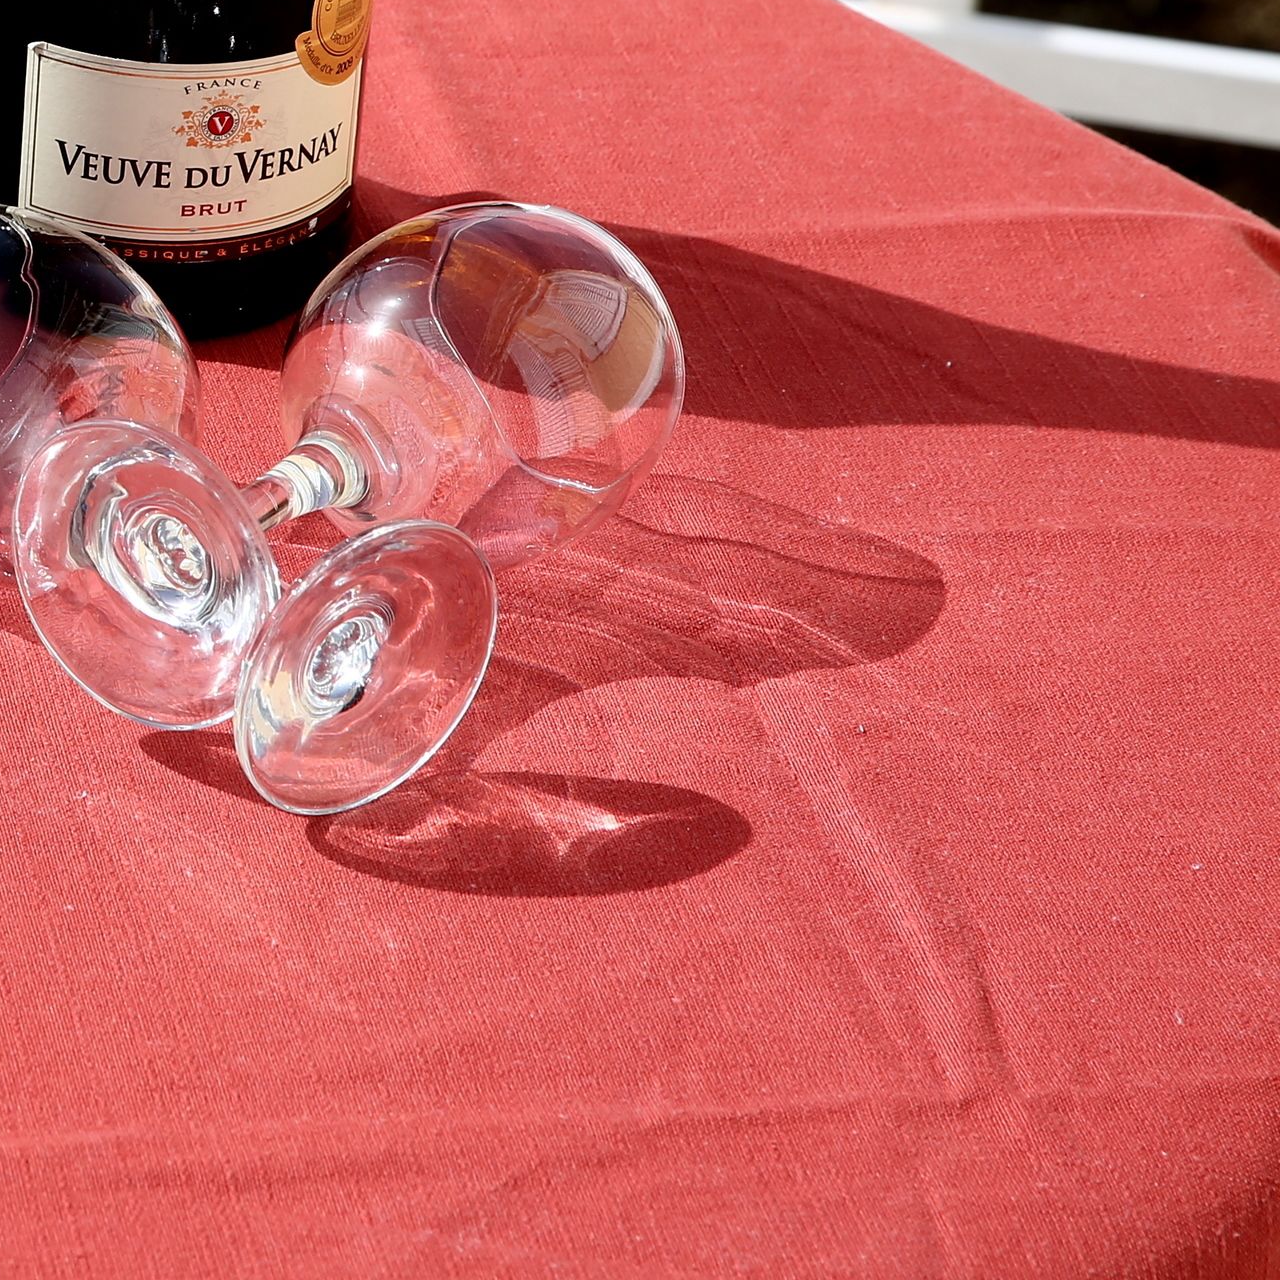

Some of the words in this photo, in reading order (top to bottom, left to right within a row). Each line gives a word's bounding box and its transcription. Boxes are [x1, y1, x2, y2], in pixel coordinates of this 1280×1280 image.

[335, 56, 354, 75] 2009
[184, 77, 262, 95] FRANCE
[212, 115, 230, 134] V
[55, 138, 172, 189] VEUVE
[184, 165, 232, 189] DU
[234, 122, 344, 184] VERNAY
[181, 200, 247, 217] BRUT
[216, 248, 228, 258] &
[240, 226, 312, 254] ÉLÉGAN
